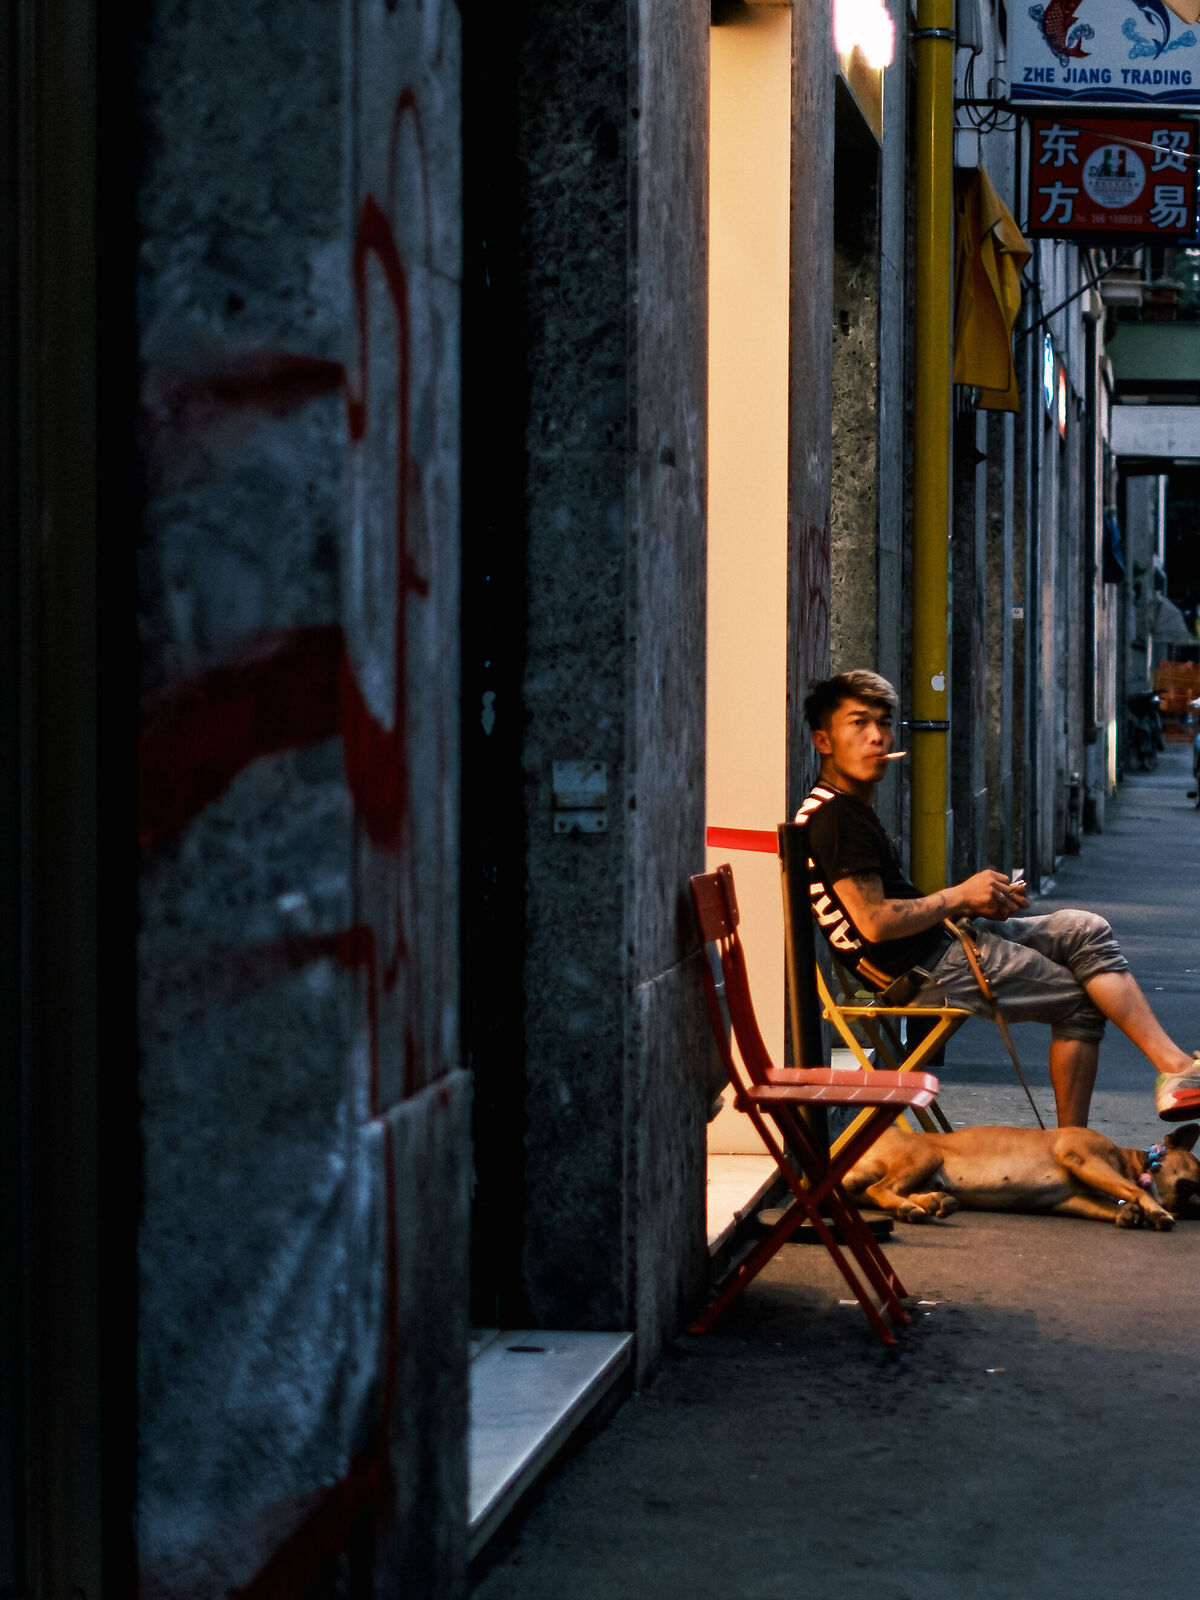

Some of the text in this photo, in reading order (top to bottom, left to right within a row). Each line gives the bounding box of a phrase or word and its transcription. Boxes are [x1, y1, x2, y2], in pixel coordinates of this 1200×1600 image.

[1023, 67, 1192, 85] ZHE JIANG TRADING
[1038, 124, 1080, 225] 东方
[1150, 129, 1190, 229] 贸易
